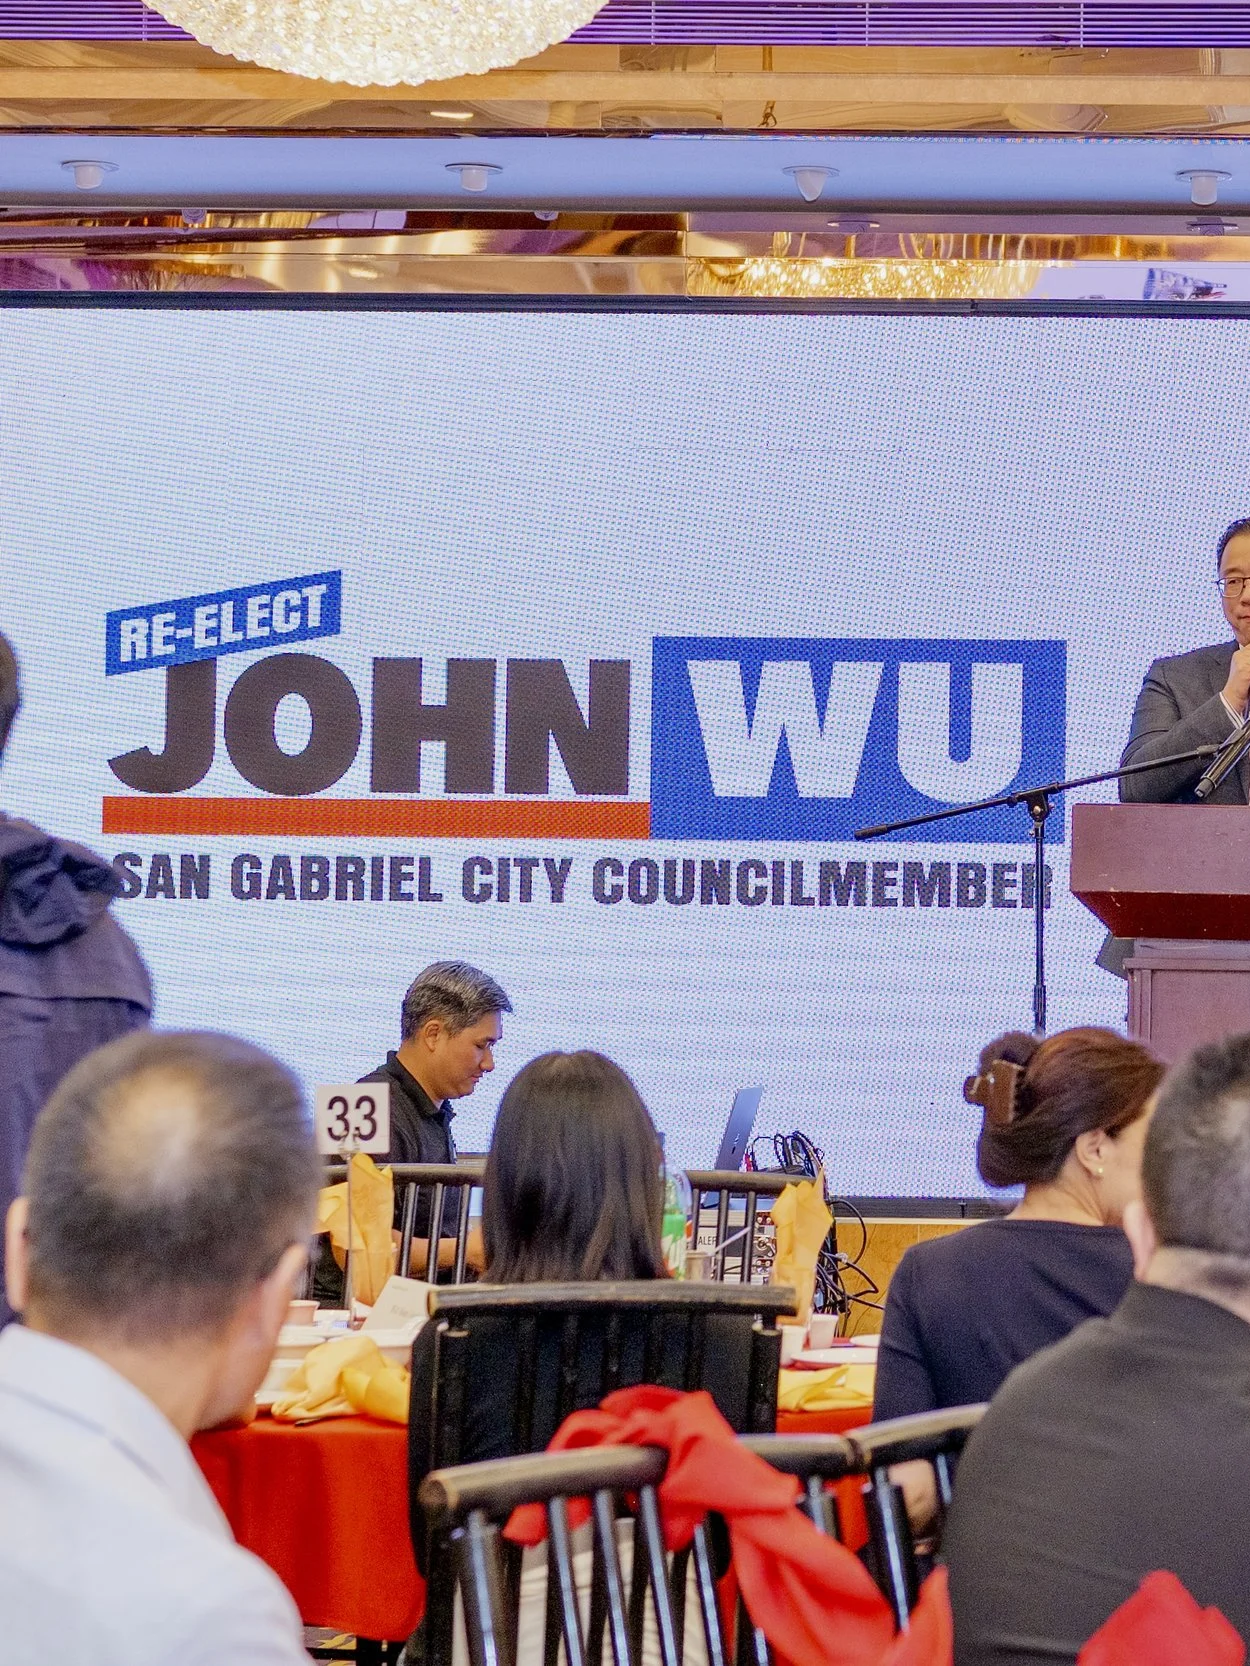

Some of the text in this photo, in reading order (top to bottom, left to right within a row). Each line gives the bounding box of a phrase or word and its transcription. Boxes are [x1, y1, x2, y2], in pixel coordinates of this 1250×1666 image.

[120, 583, 327, 663] RE-ELECT
[107, 652, 1023, 804] JOHN WU
[113, 852, 1052, 909] SAN GABRIEL CITY COUNCILMEMBER
[327, 1095, 377, 1141] 33
